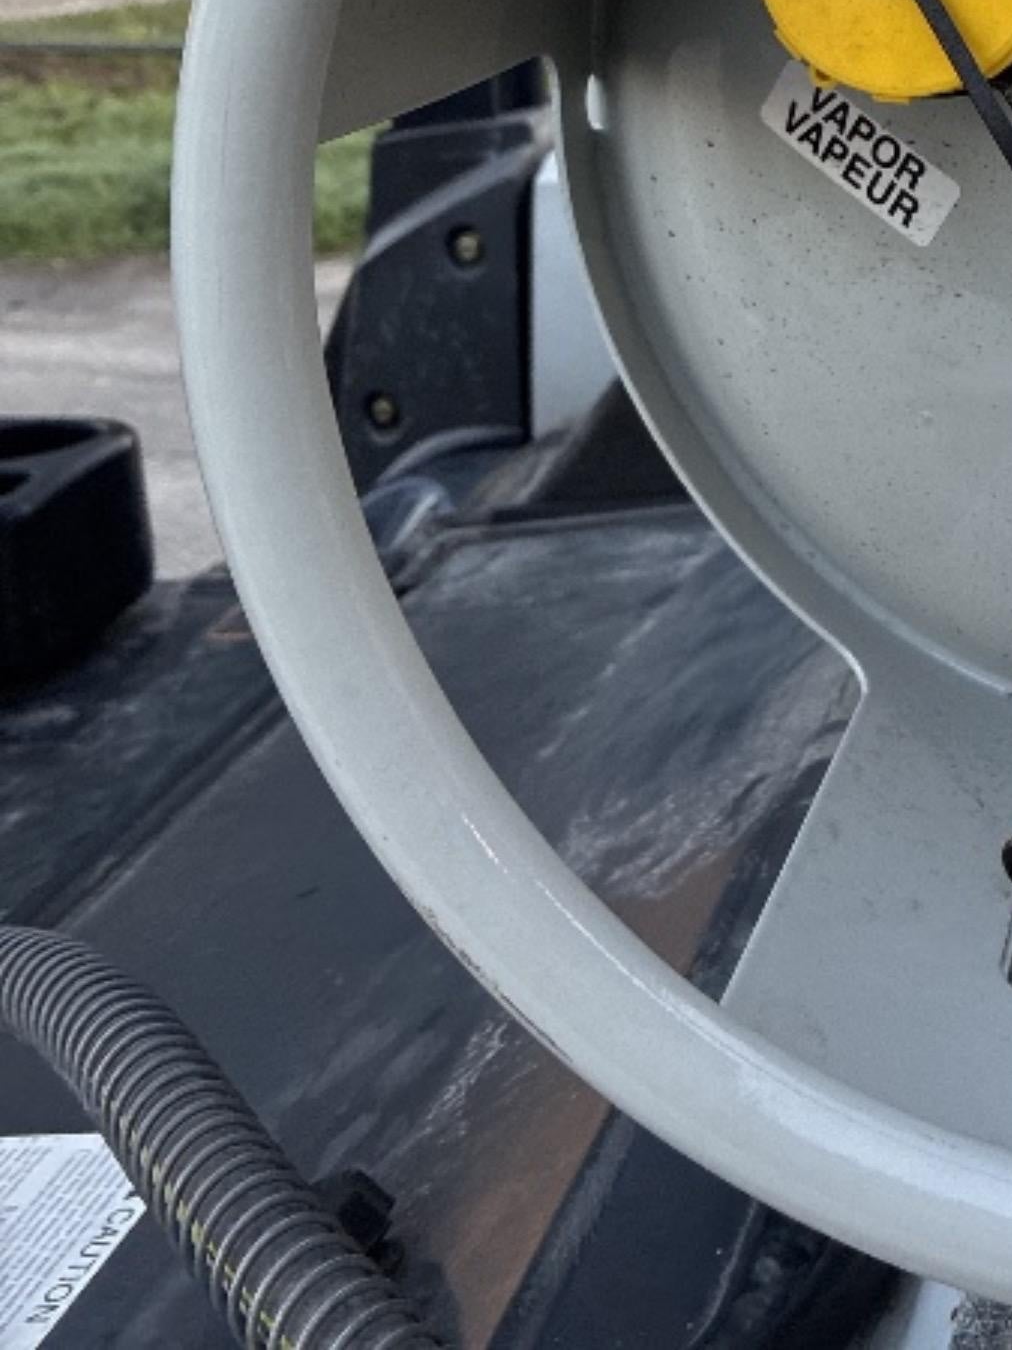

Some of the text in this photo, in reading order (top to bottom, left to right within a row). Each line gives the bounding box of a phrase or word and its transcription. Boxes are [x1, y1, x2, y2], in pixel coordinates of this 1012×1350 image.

[785, 99, 919, 228] VAPEUR
[811, 86, 926, 190] VAPOR
[25, 1206, 136, 1326] CAUTION
